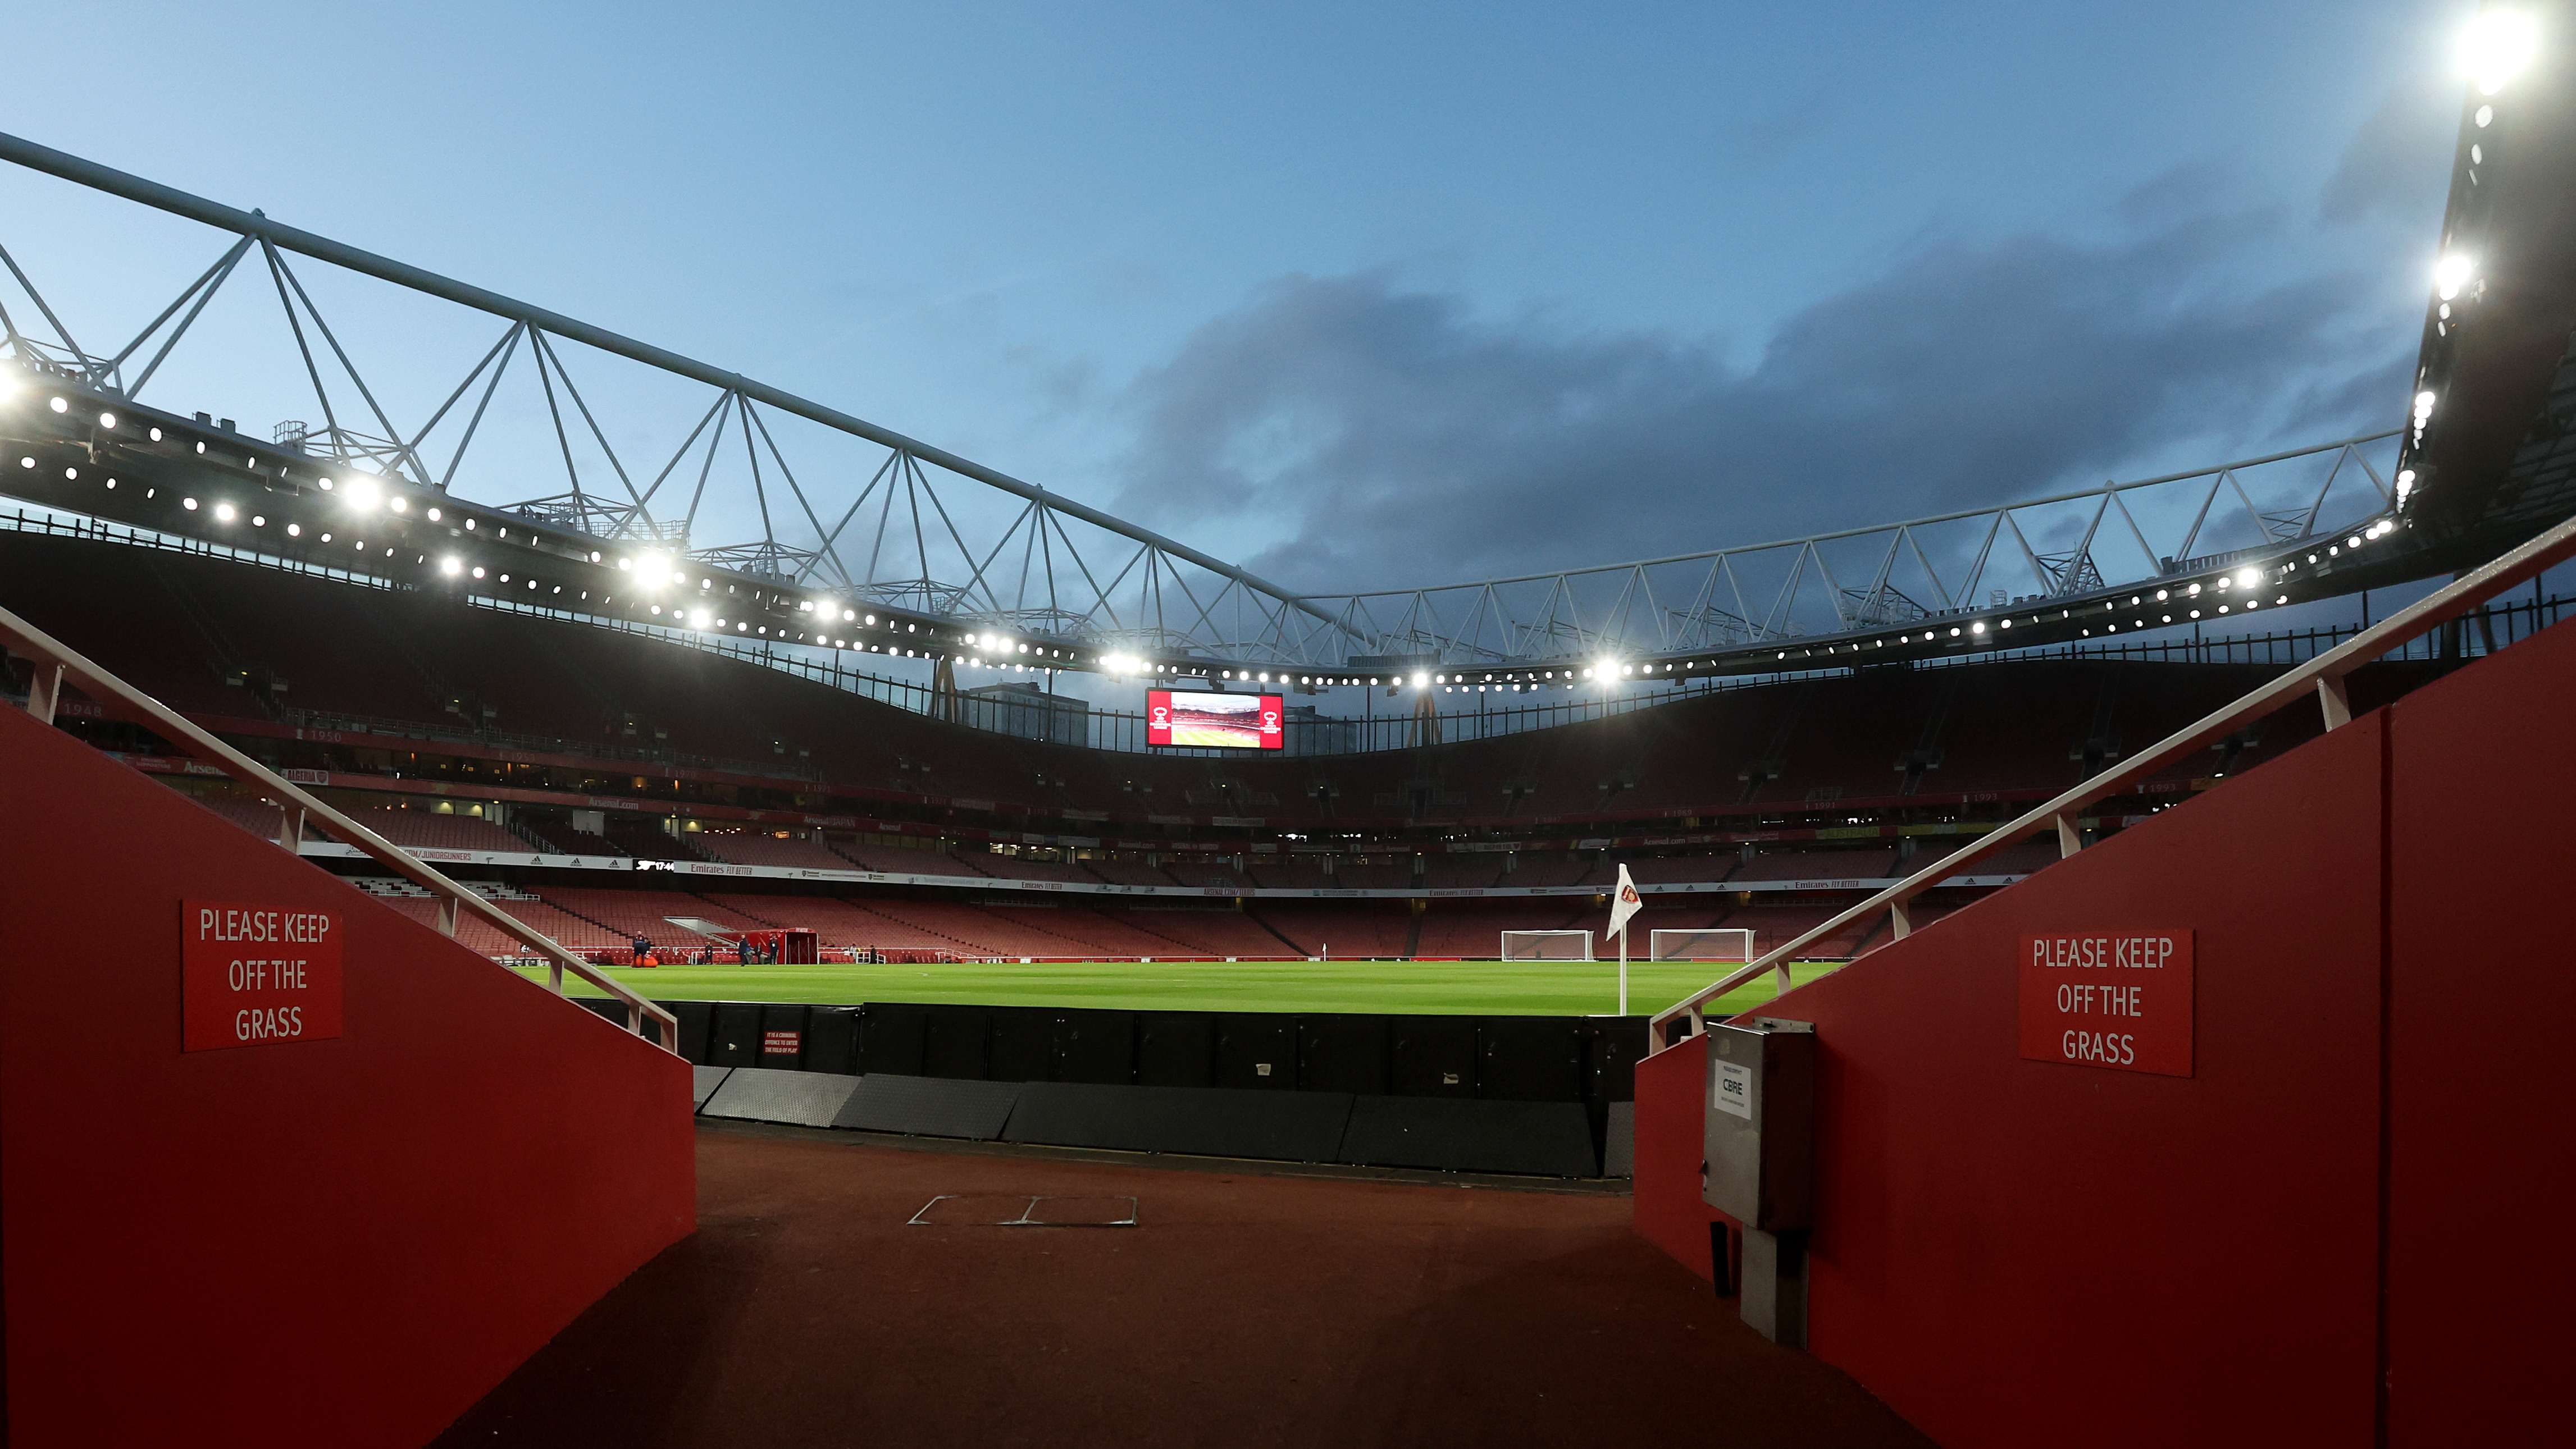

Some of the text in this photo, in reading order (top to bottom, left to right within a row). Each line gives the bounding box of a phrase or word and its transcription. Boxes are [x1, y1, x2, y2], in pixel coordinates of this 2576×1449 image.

[63, 703, 102, 717] 1948
[312, 730, 341, 742] 1950
[589, 796, 639, 810] Arsenal.com
[1974, 793, 1998, 802] 1993
[691, 863, 753, 875] Emirates FLY BETTER
[1795, 881, 1829, 889] Emirates
[200, 908, 330, 944] PLEASE KEEP
[2032, 937, 2173, 969] PLEASE KEEP
[229, 959, 307, 991] OFF THE
[2057, 984, 2142, 1017] OFF THE
[236, 1006, 302, 1041] GRASS
[2063, 1030, 2135, 1065] GRASS
[1723, 1078, 1743, 1096] CBRE
